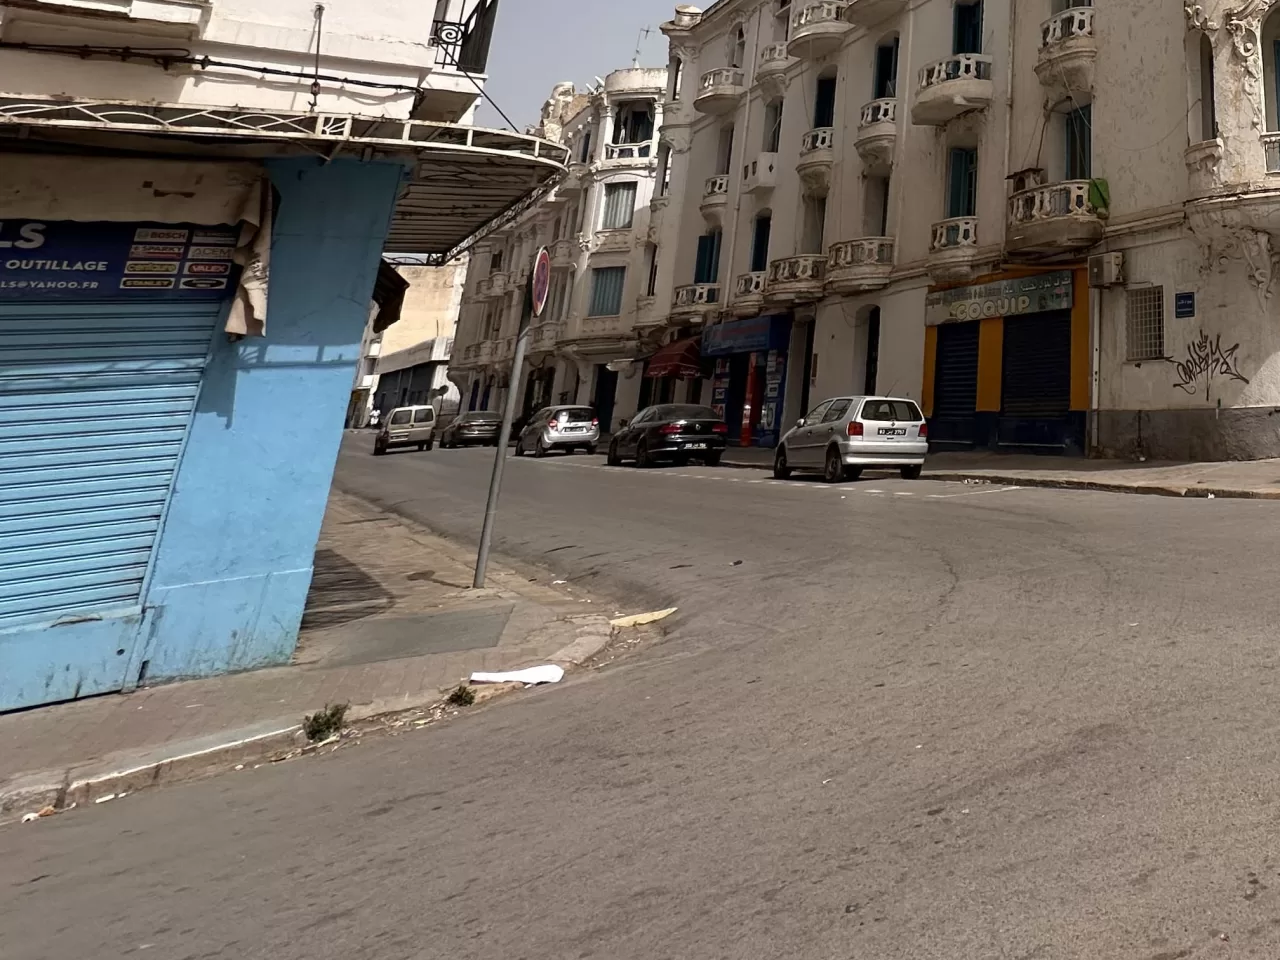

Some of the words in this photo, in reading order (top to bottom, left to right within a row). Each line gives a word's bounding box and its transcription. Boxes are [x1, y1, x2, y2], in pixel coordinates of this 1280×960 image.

[150, 230, 186, 239] BOSCH
[5, 260, 108, 271] OUTILLAGE
[192, 264, 227, 272] VALEX
